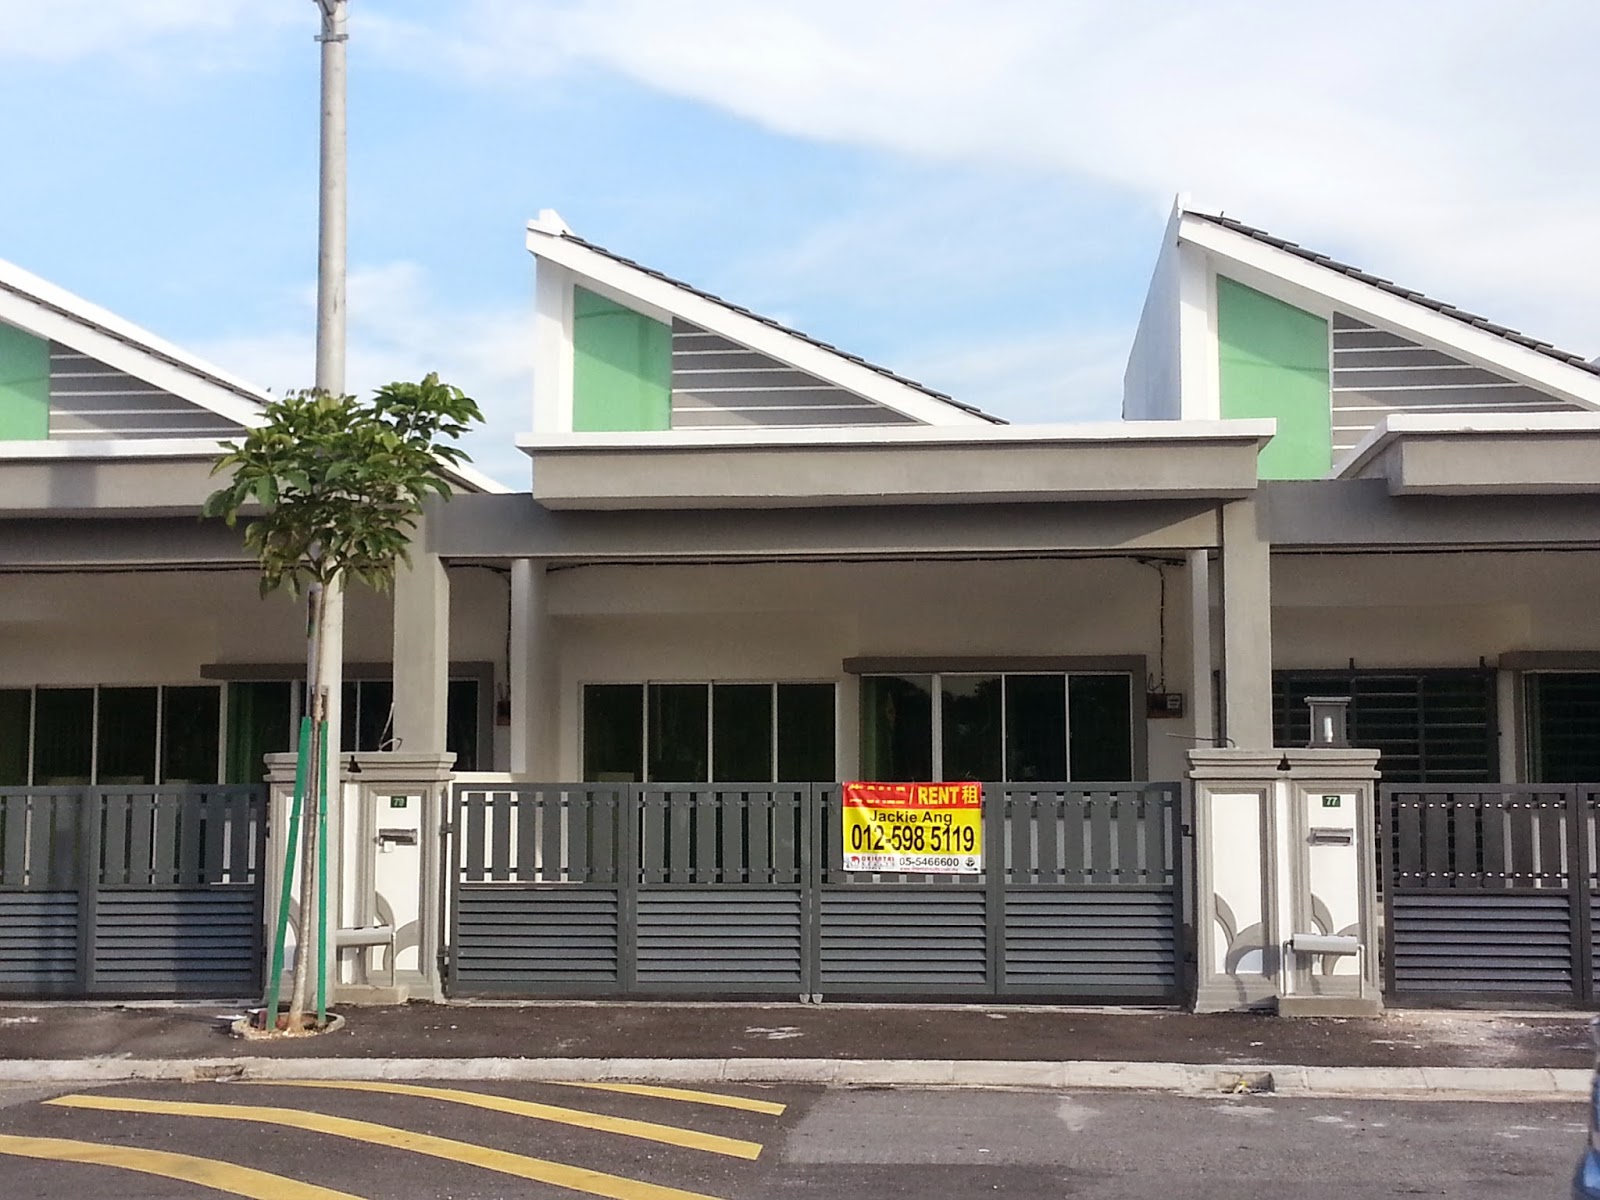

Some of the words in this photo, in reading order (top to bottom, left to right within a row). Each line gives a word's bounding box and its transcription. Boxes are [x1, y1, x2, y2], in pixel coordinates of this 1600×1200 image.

[918, 786, 960, 805] RENT
[962, 785, 979, 804] 租
[1325, 796, 1338, 806] 77
[870, 810, 918, 823] Jackie
[922, 811, 953, 825] Ang
[930, 825, 975, 852] 5119
[899, 857, 960, 867] 05-5466600
